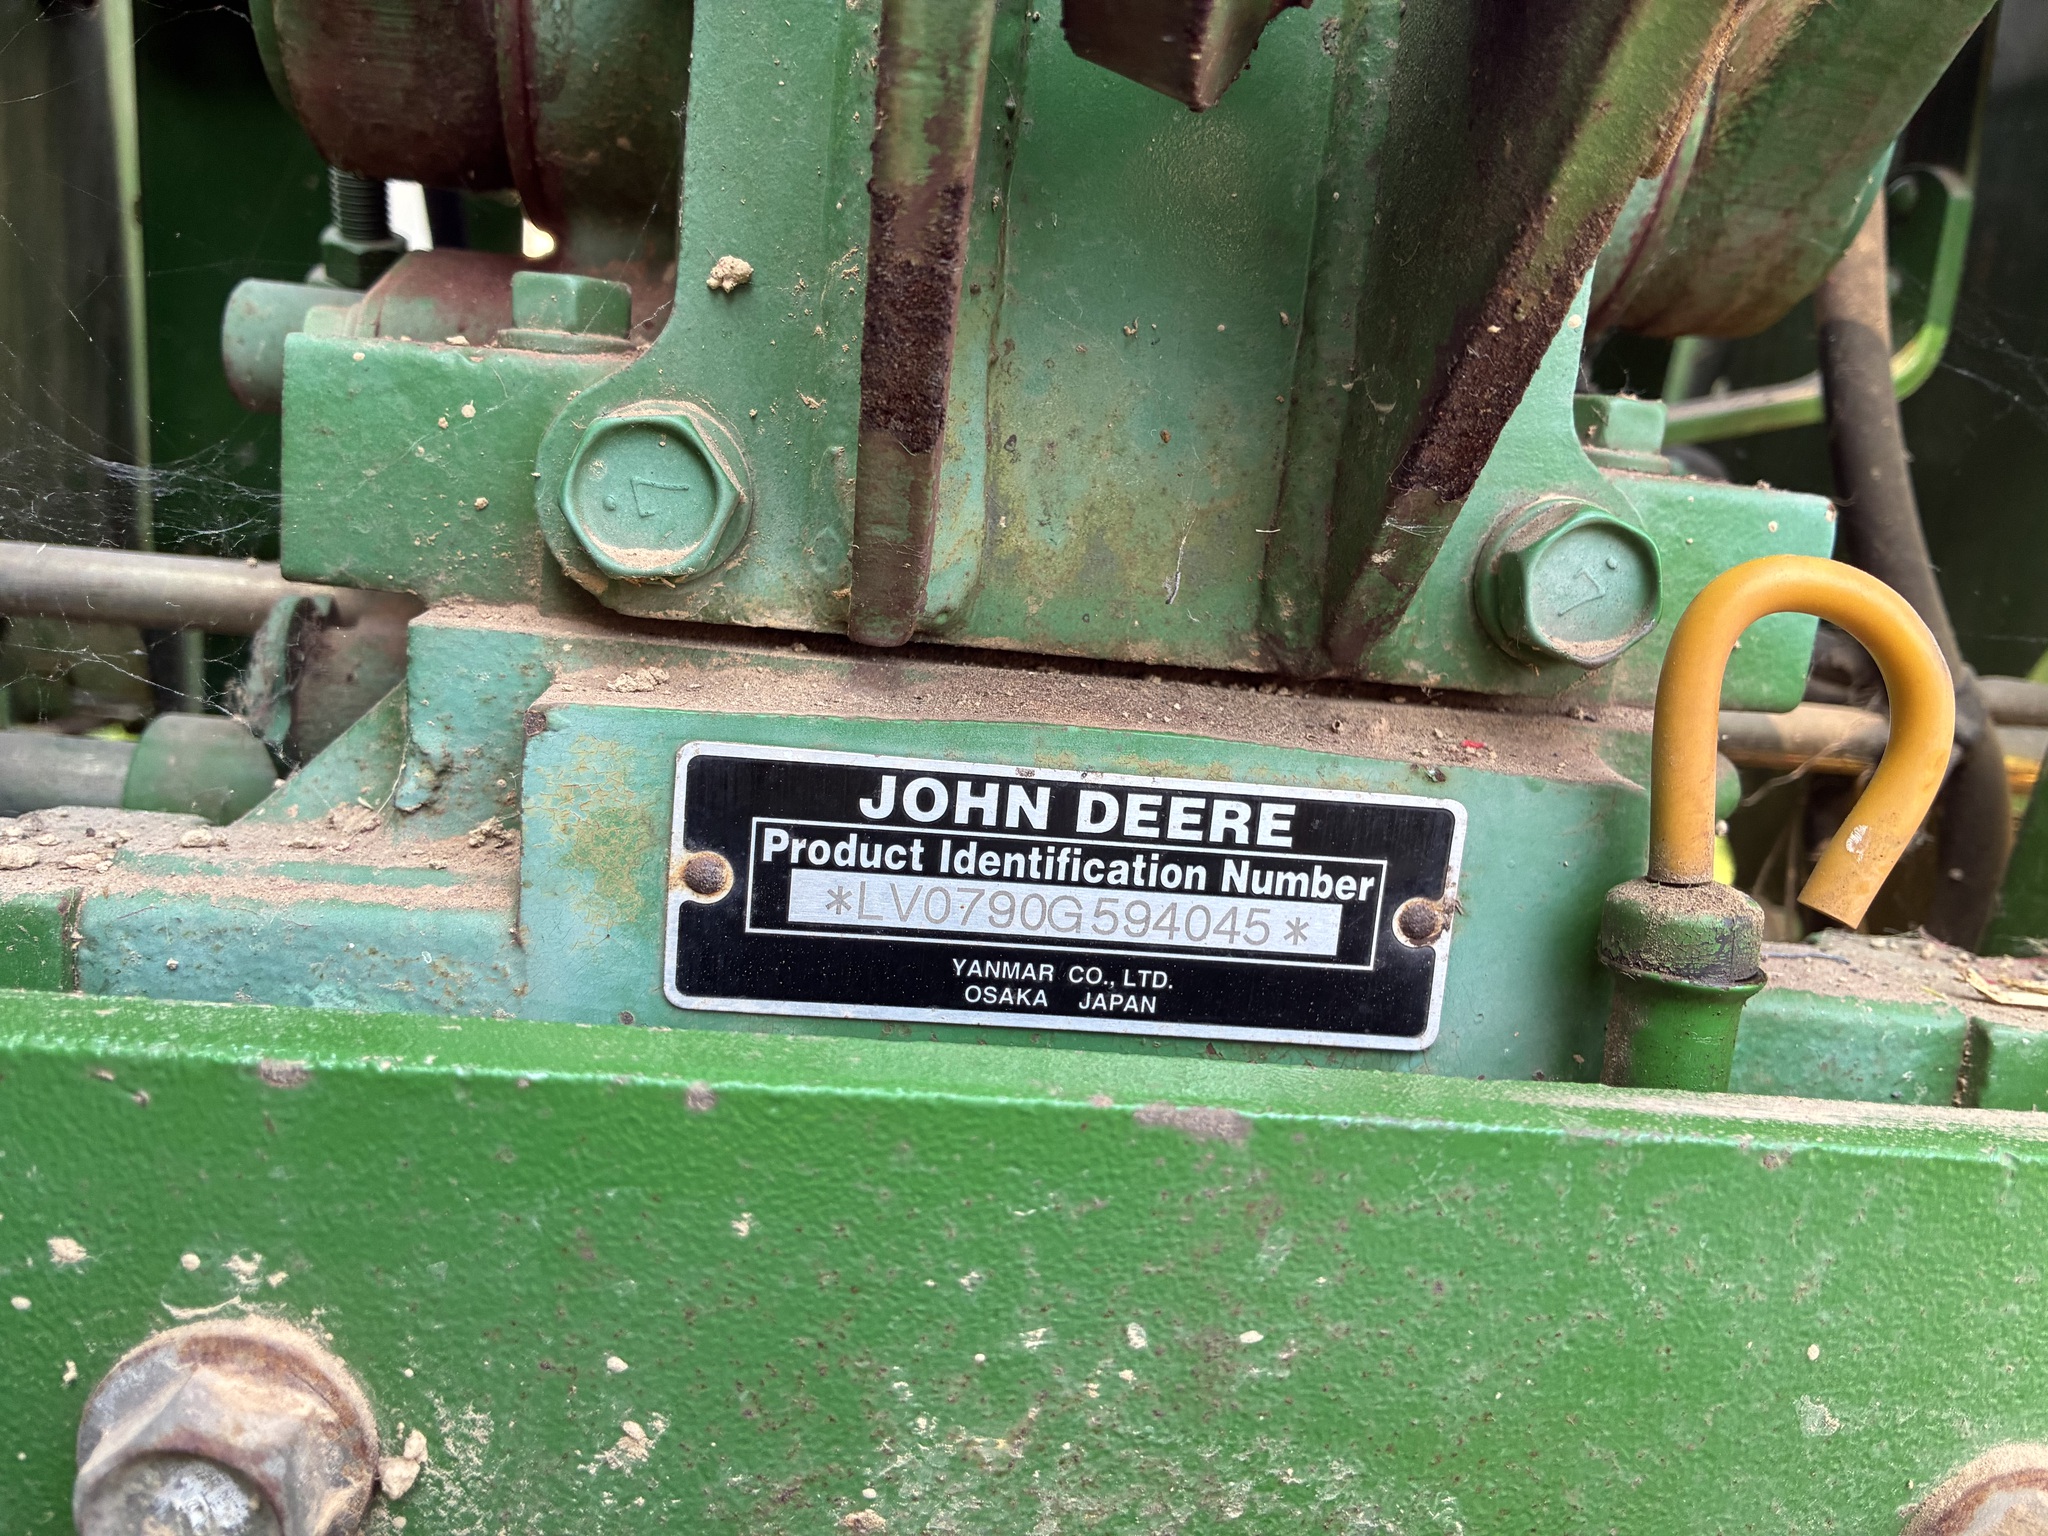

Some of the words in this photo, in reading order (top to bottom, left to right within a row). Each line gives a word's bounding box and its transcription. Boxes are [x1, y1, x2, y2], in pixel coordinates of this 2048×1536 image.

[859, 774, 1051, 830] JOHN
[1075, 789, 1297, 848] DEERE
[762, 827, 925, 872] Product
[939, 839, 1207, 891] Identification
[1220, 858, 1375, 901] Number
[952, 958, 1055, 982] YANMAR
[1068, 965, 1115, 989] CO.,
[1123, 969, 1174, 990] LTD.
[964, 985, 1049, 1007] OSAKA
[1078, 992, 1157, 1014] JAPAN
